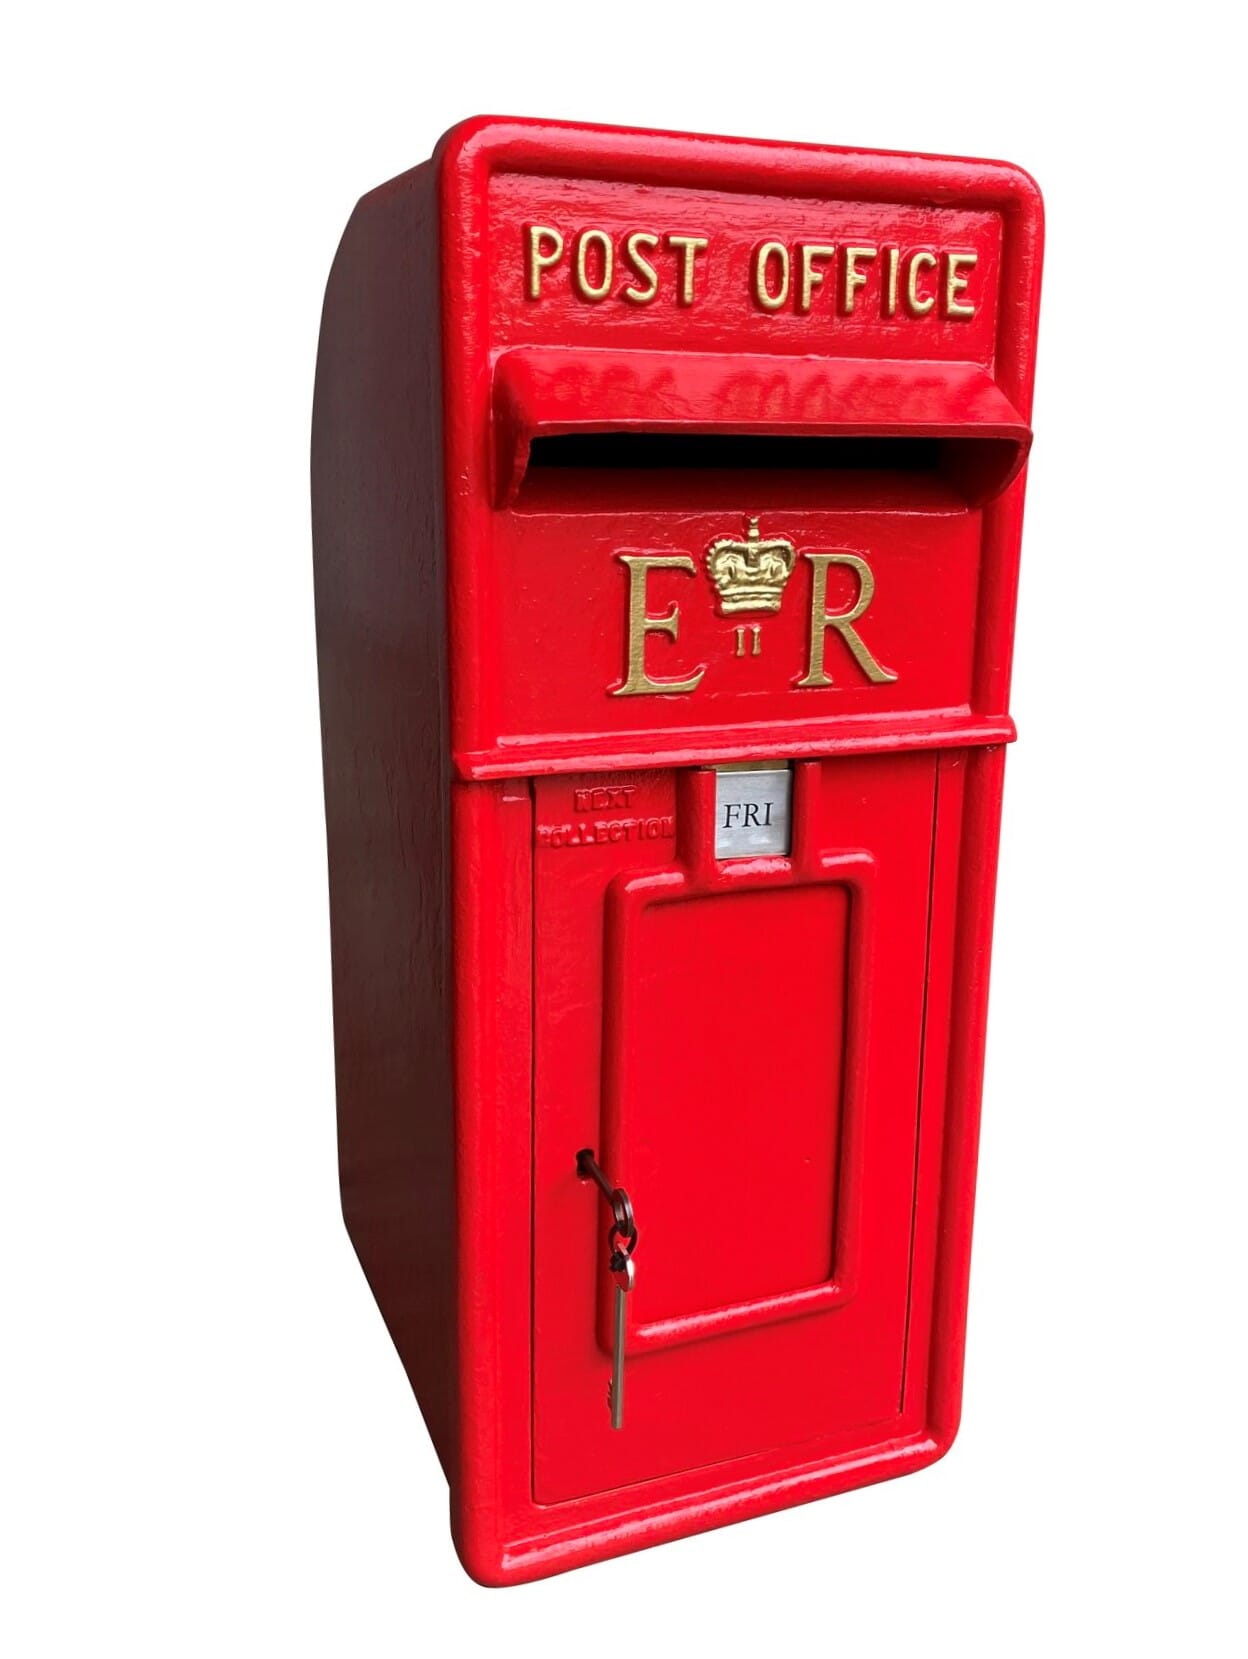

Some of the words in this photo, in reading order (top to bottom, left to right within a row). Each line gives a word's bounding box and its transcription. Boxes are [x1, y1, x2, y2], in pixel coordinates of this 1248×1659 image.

[529, 225, 708, 304] POST
[756, 241, 978, 317] OFFICE
[612, 555, 705, 695] E
[798, 553, 898, 686] R
[735, 626, 761, 657] II
[574, 785, 636, 812] NEXT
[722, 802, 775, 829] FRI
